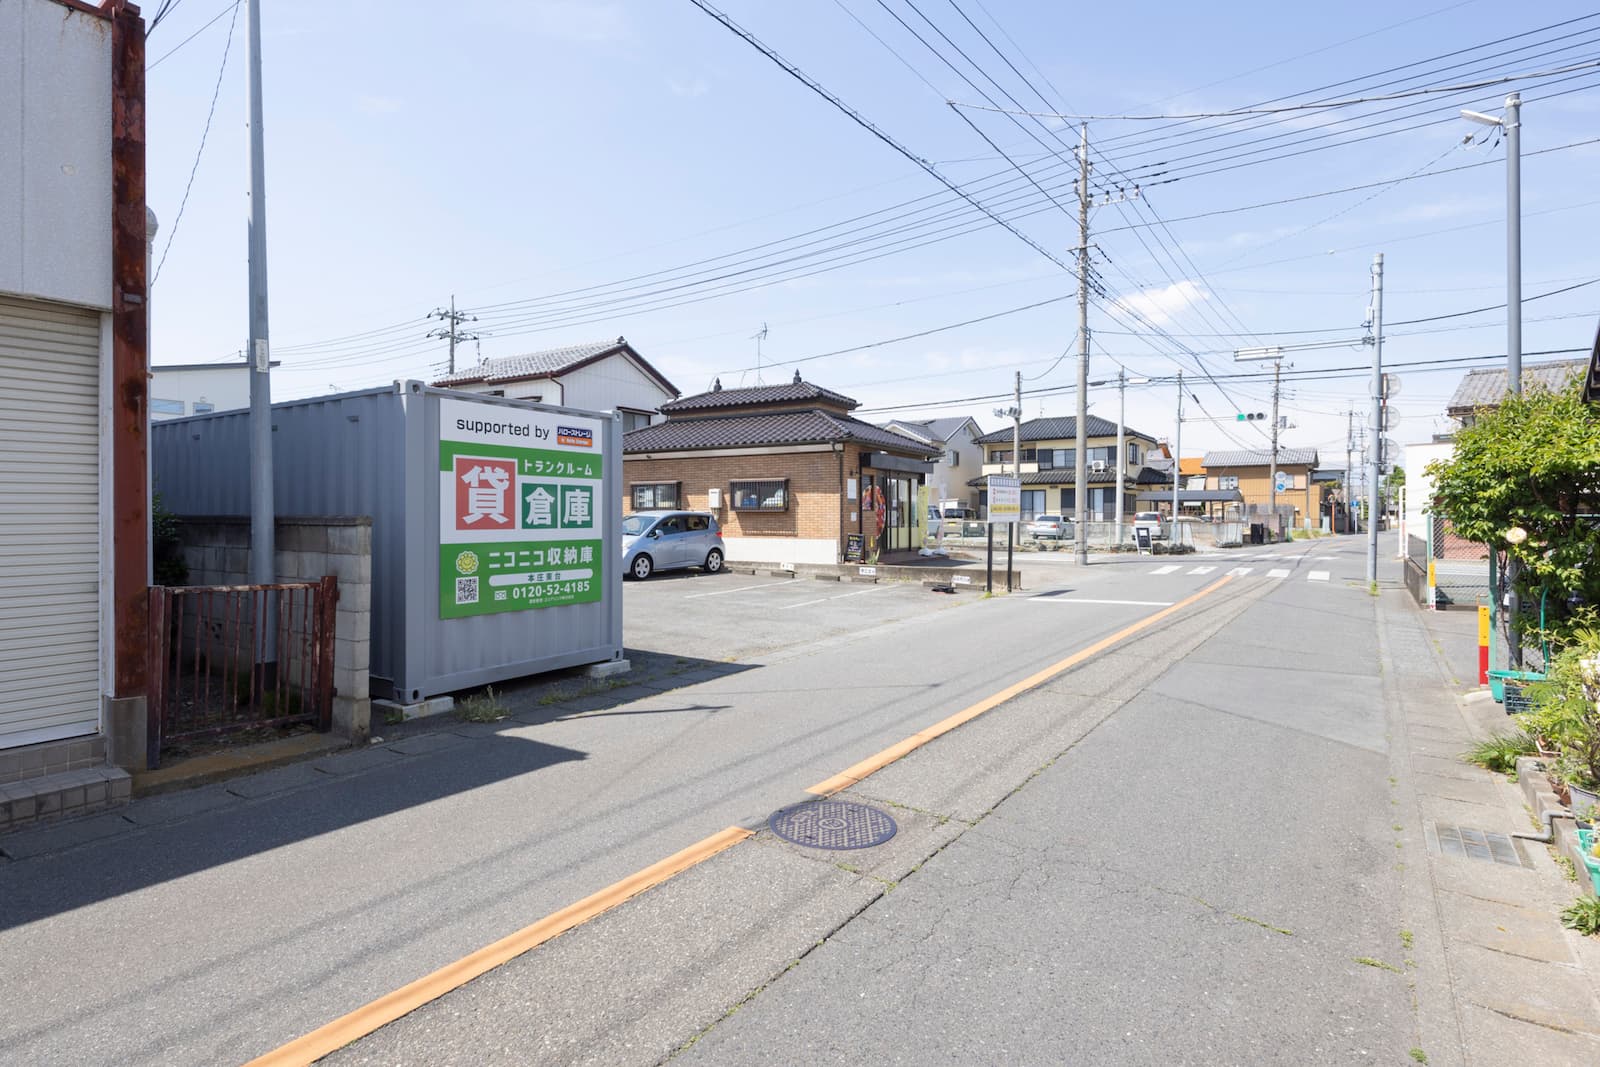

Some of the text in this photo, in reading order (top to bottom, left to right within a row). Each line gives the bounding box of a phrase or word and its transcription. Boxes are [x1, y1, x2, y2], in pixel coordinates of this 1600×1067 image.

[456, 418, 550, 441] supported by
[524, 459, 593, 476] トランクルーム
[461, 466, 592, 525] 貸倉庫
[488, 546, 594, 569] ニコニコ収納庫
[512, 581, 590, 599] 0120-52-4185
